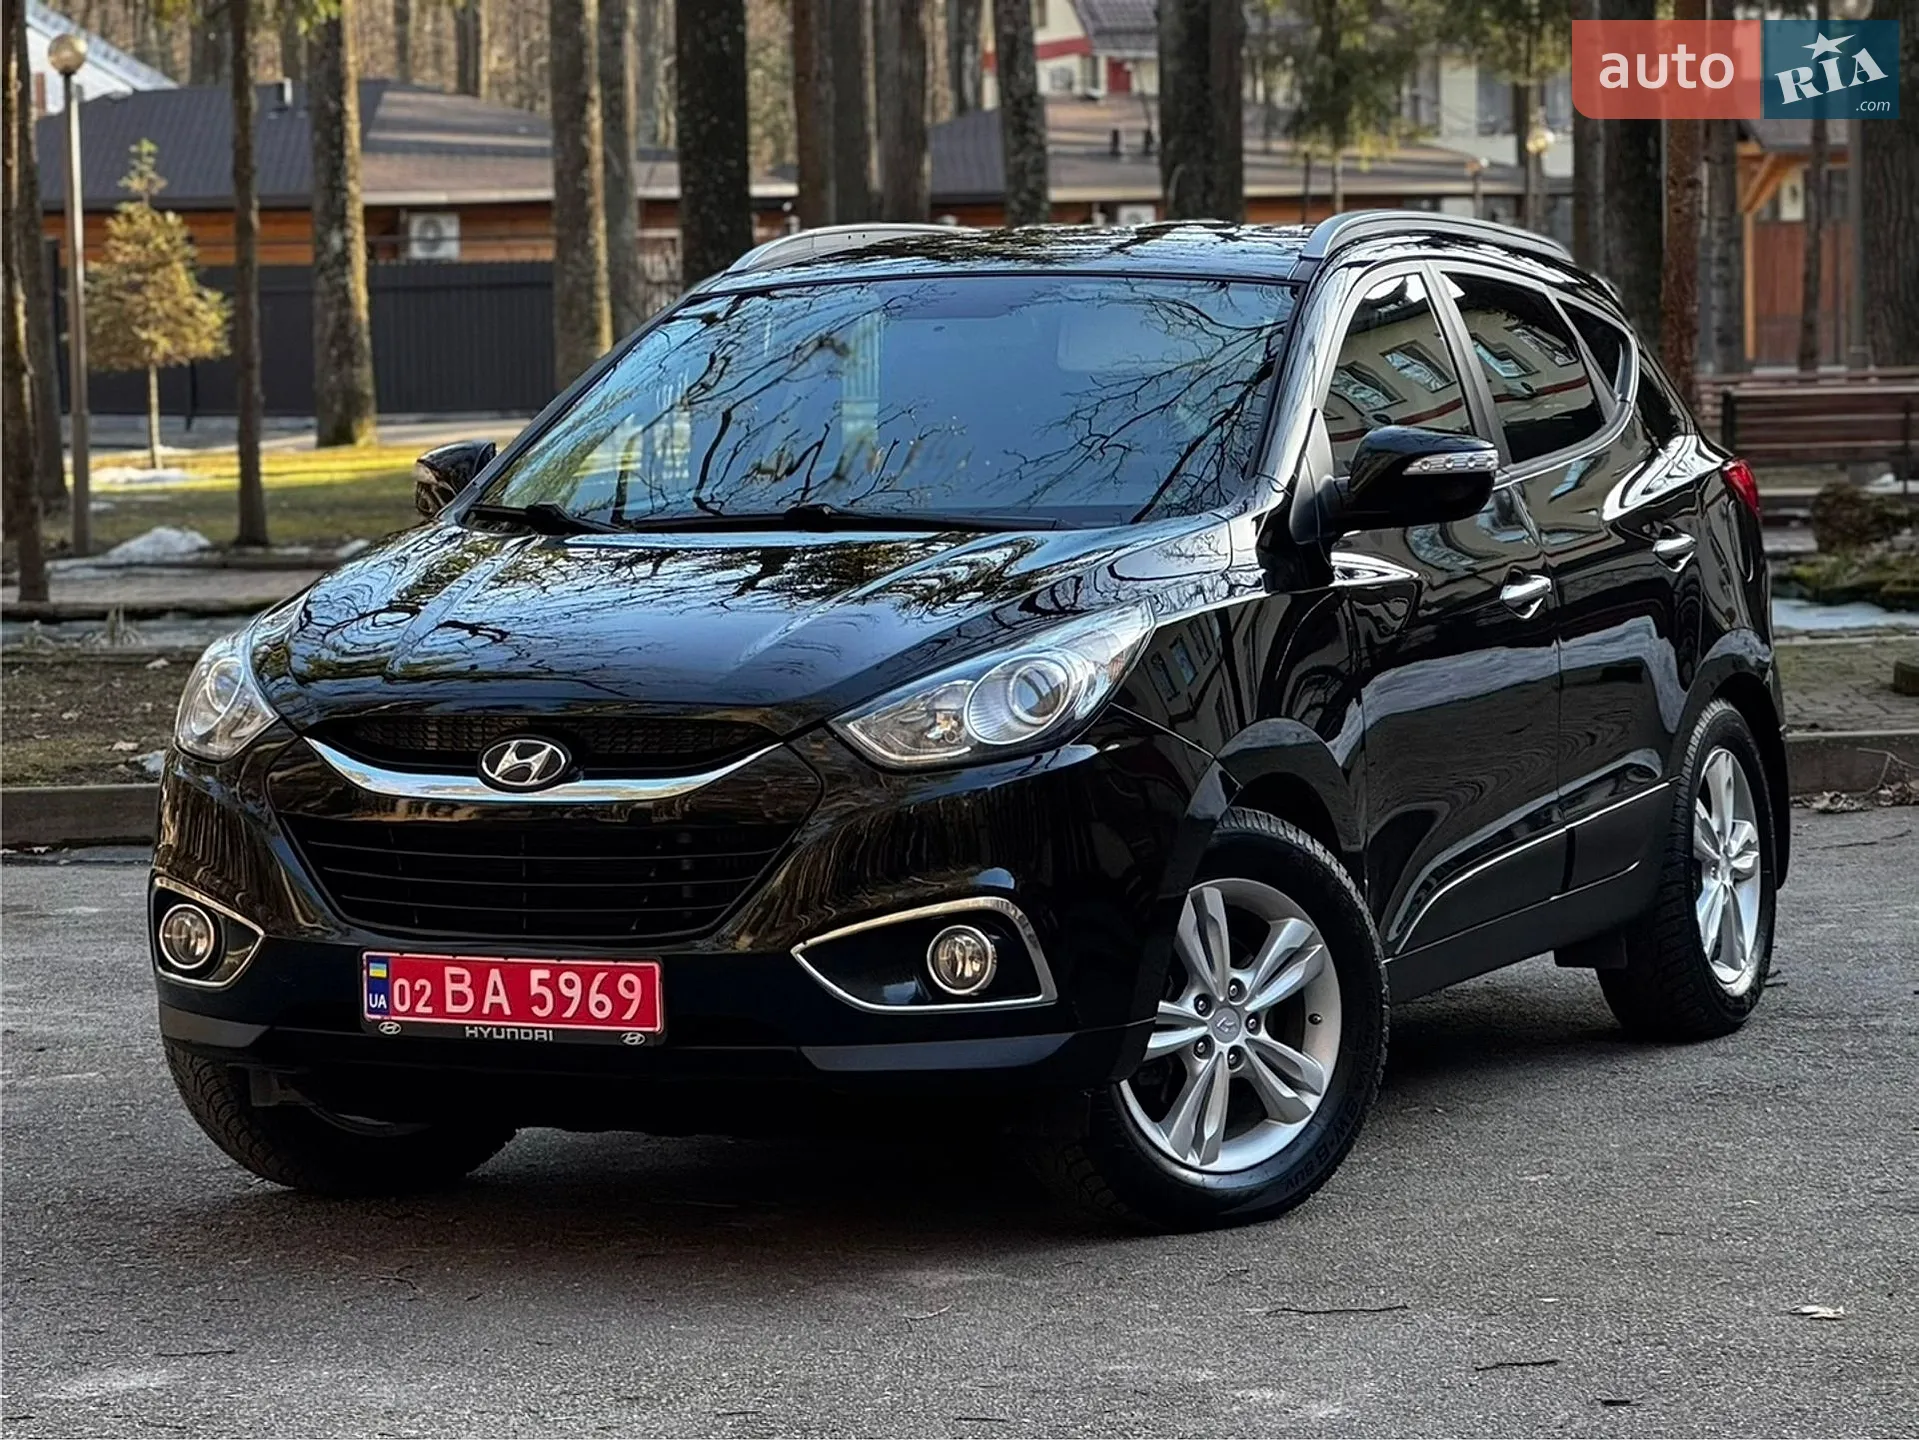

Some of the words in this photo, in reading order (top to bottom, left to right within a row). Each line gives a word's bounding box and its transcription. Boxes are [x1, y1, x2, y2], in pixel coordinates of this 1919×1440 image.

[369, 993, 387, 1009] UA
[393, 978, 433, 1014] 02
[444, 967, 512, 1016] BA
[529, 969, 643, 1020] 5969
[465, 1026, 553, 1041] HYUNDAI
